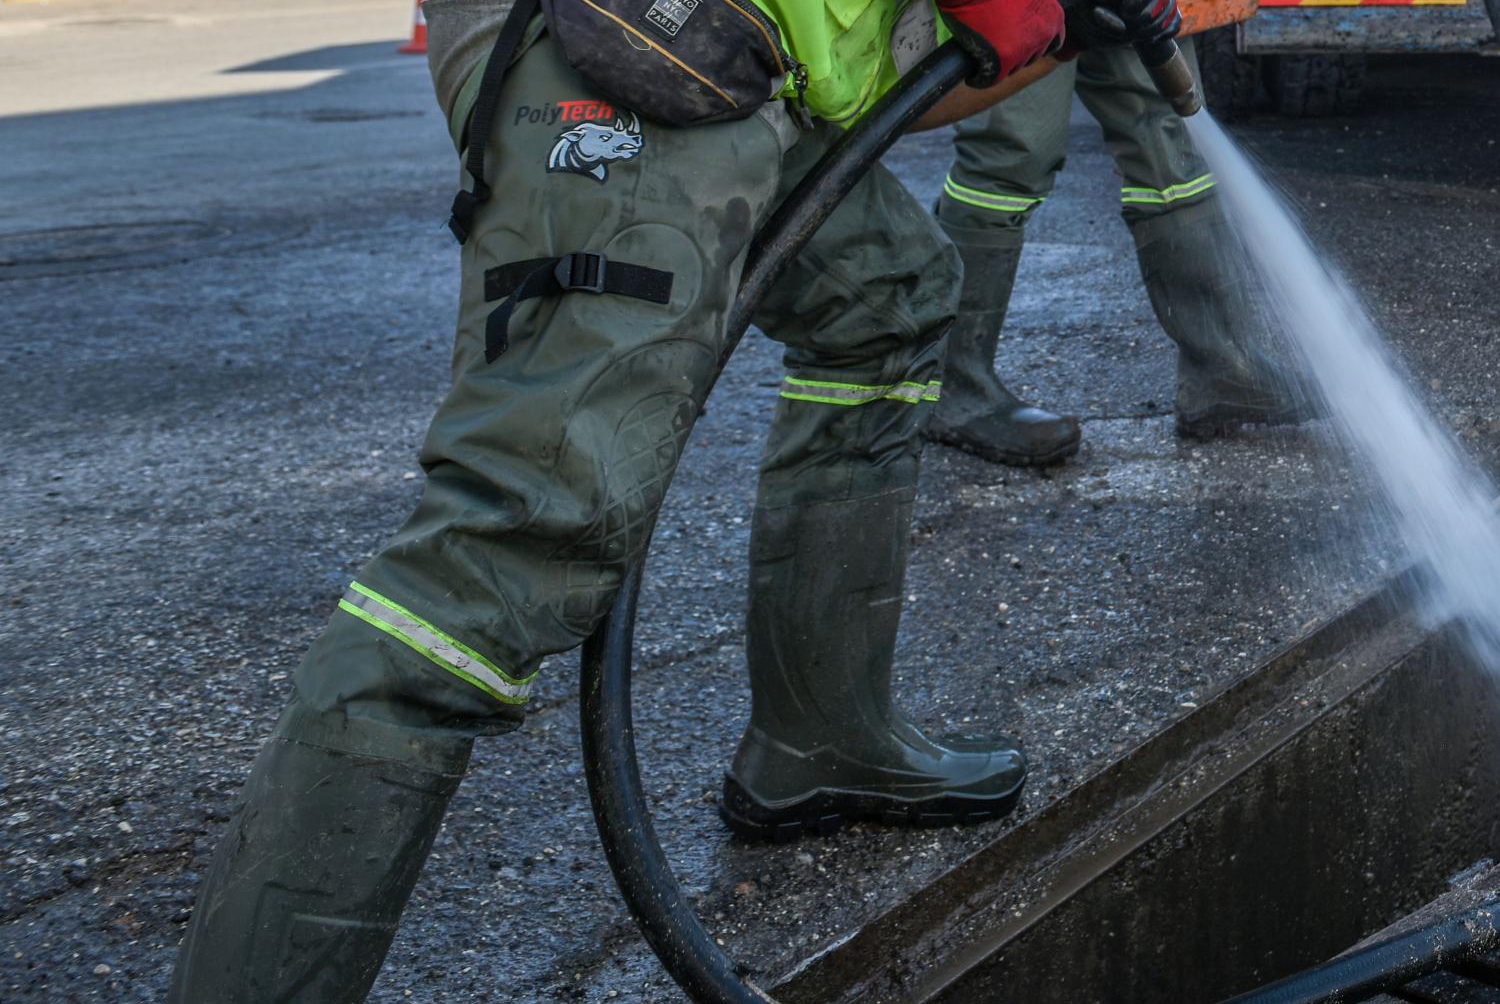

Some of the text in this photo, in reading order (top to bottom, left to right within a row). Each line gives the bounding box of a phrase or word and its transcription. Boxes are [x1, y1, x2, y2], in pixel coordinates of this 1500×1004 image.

[650, 9, 678, 32] PARIS
[663, 1, 682, 17] NYC
[514, 100, 613, 126] PolyTech
